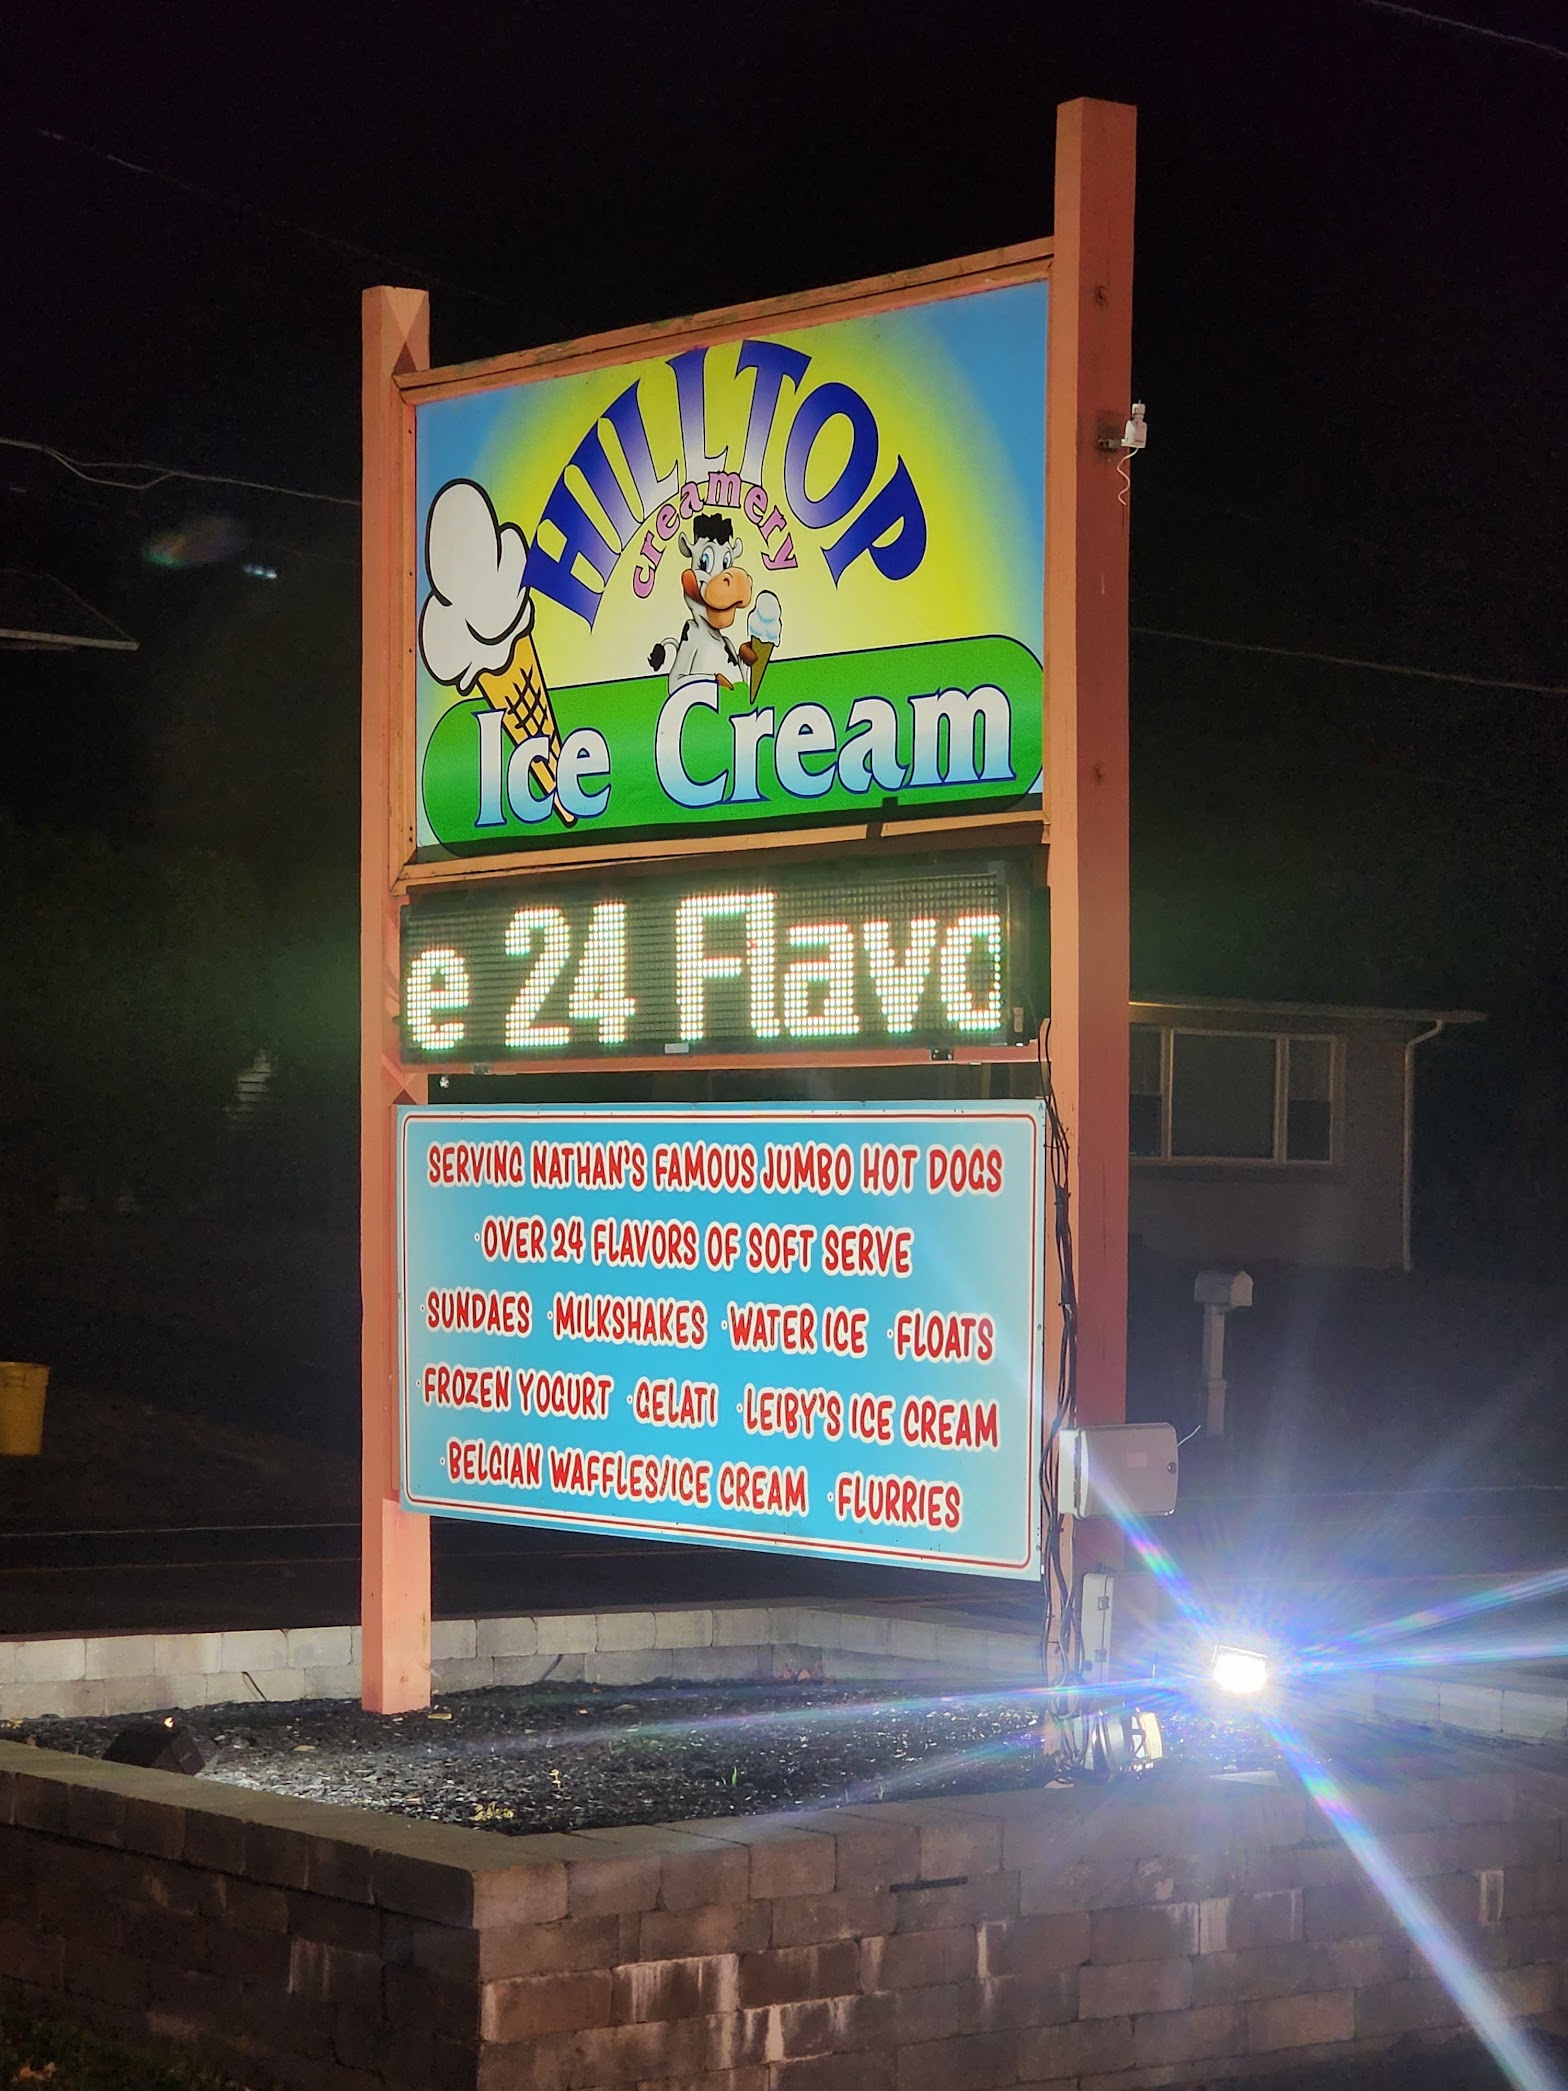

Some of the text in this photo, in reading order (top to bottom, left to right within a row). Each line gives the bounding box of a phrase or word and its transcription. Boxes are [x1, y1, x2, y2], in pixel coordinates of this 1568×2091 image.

[522, 339, 927, 633] HILLTOP
[633, 470, 798, 598] creamery
[475, 680, 1017, 828] Ice Cream
[407, 948, 468, 1050] e
[504, 901, 635, 1047] 24
[428, 1143, 1002, 1193] SERVING NATHAN'S FAMOUS JUMBO HOT DOGS
[483, 1219, 913, 1274] OVER 24 FLAVORS OF SOFT SERVE
[427, 1290, 995, 1360] SUNDAES MILKSHAKES WATER ICE FLOATS
[424, 1366, 998, 1447] FROZEN YOGURT GELATI LEIBY'S ICE CREAM
[449, 1440, 961, 1528] BELGIAN WAFFLES/ICE CREAM FLURRIES
